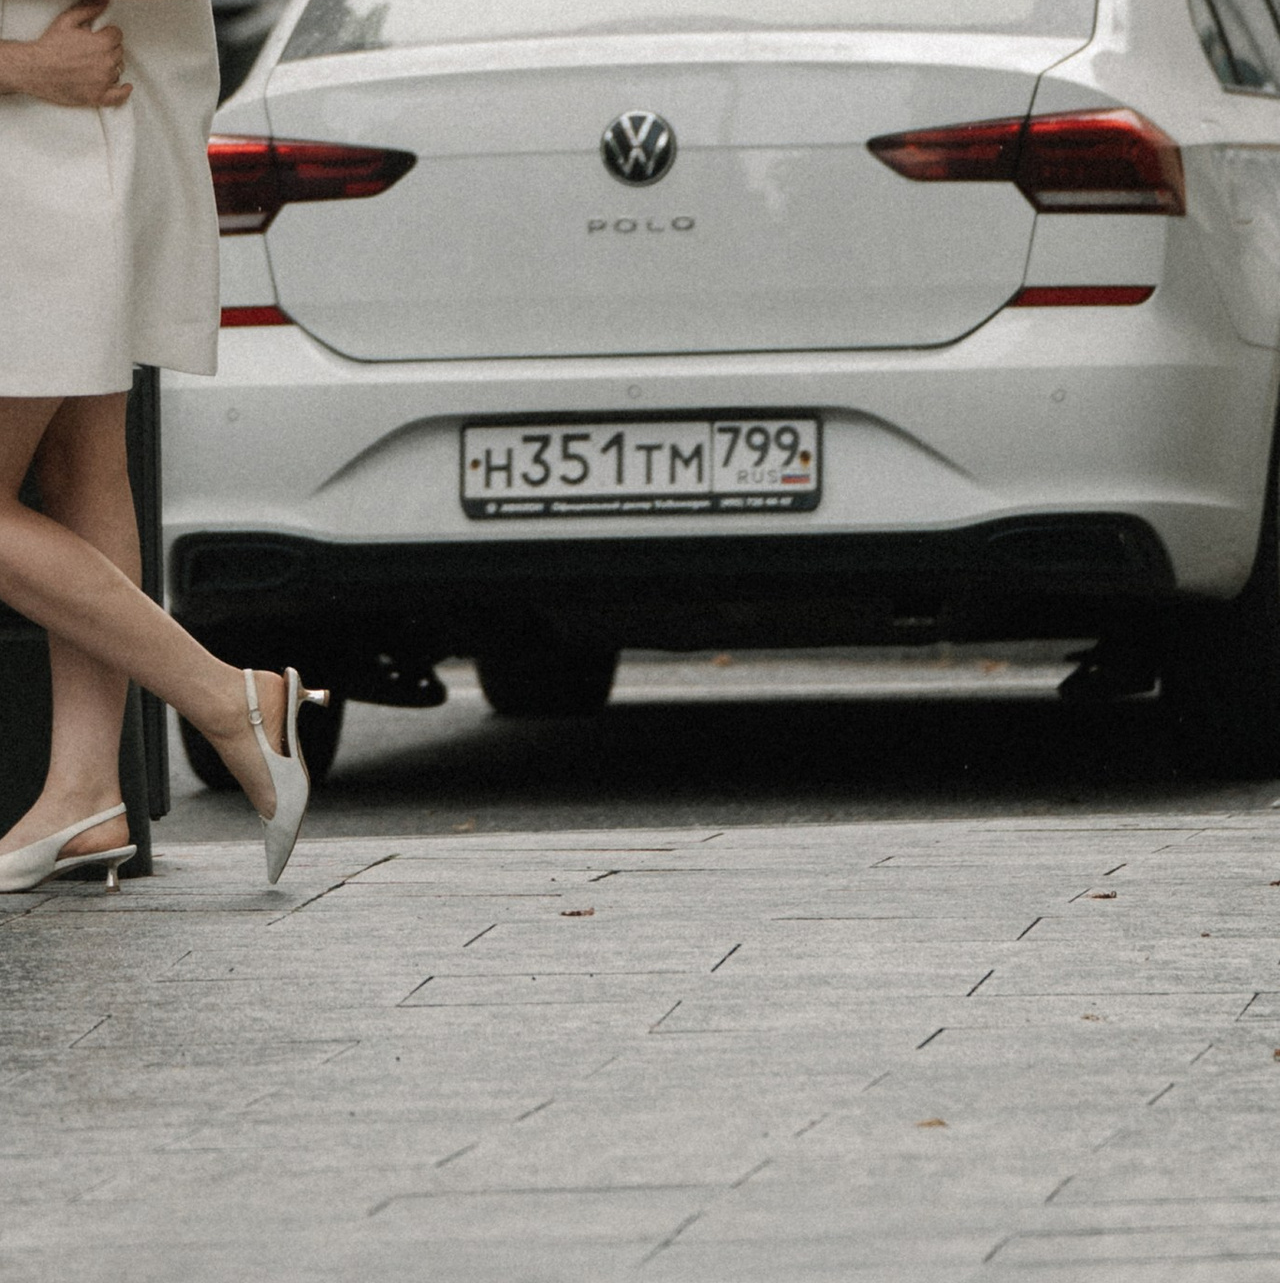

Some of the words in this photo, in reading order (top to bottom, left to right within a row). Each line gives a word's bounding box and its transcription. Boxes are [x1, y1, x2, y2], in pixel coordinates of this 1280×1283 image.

[587, 216, 696, 234] POLO
[716, 425, 802, 469] 799
[737, 469, 779, 485] RUS
